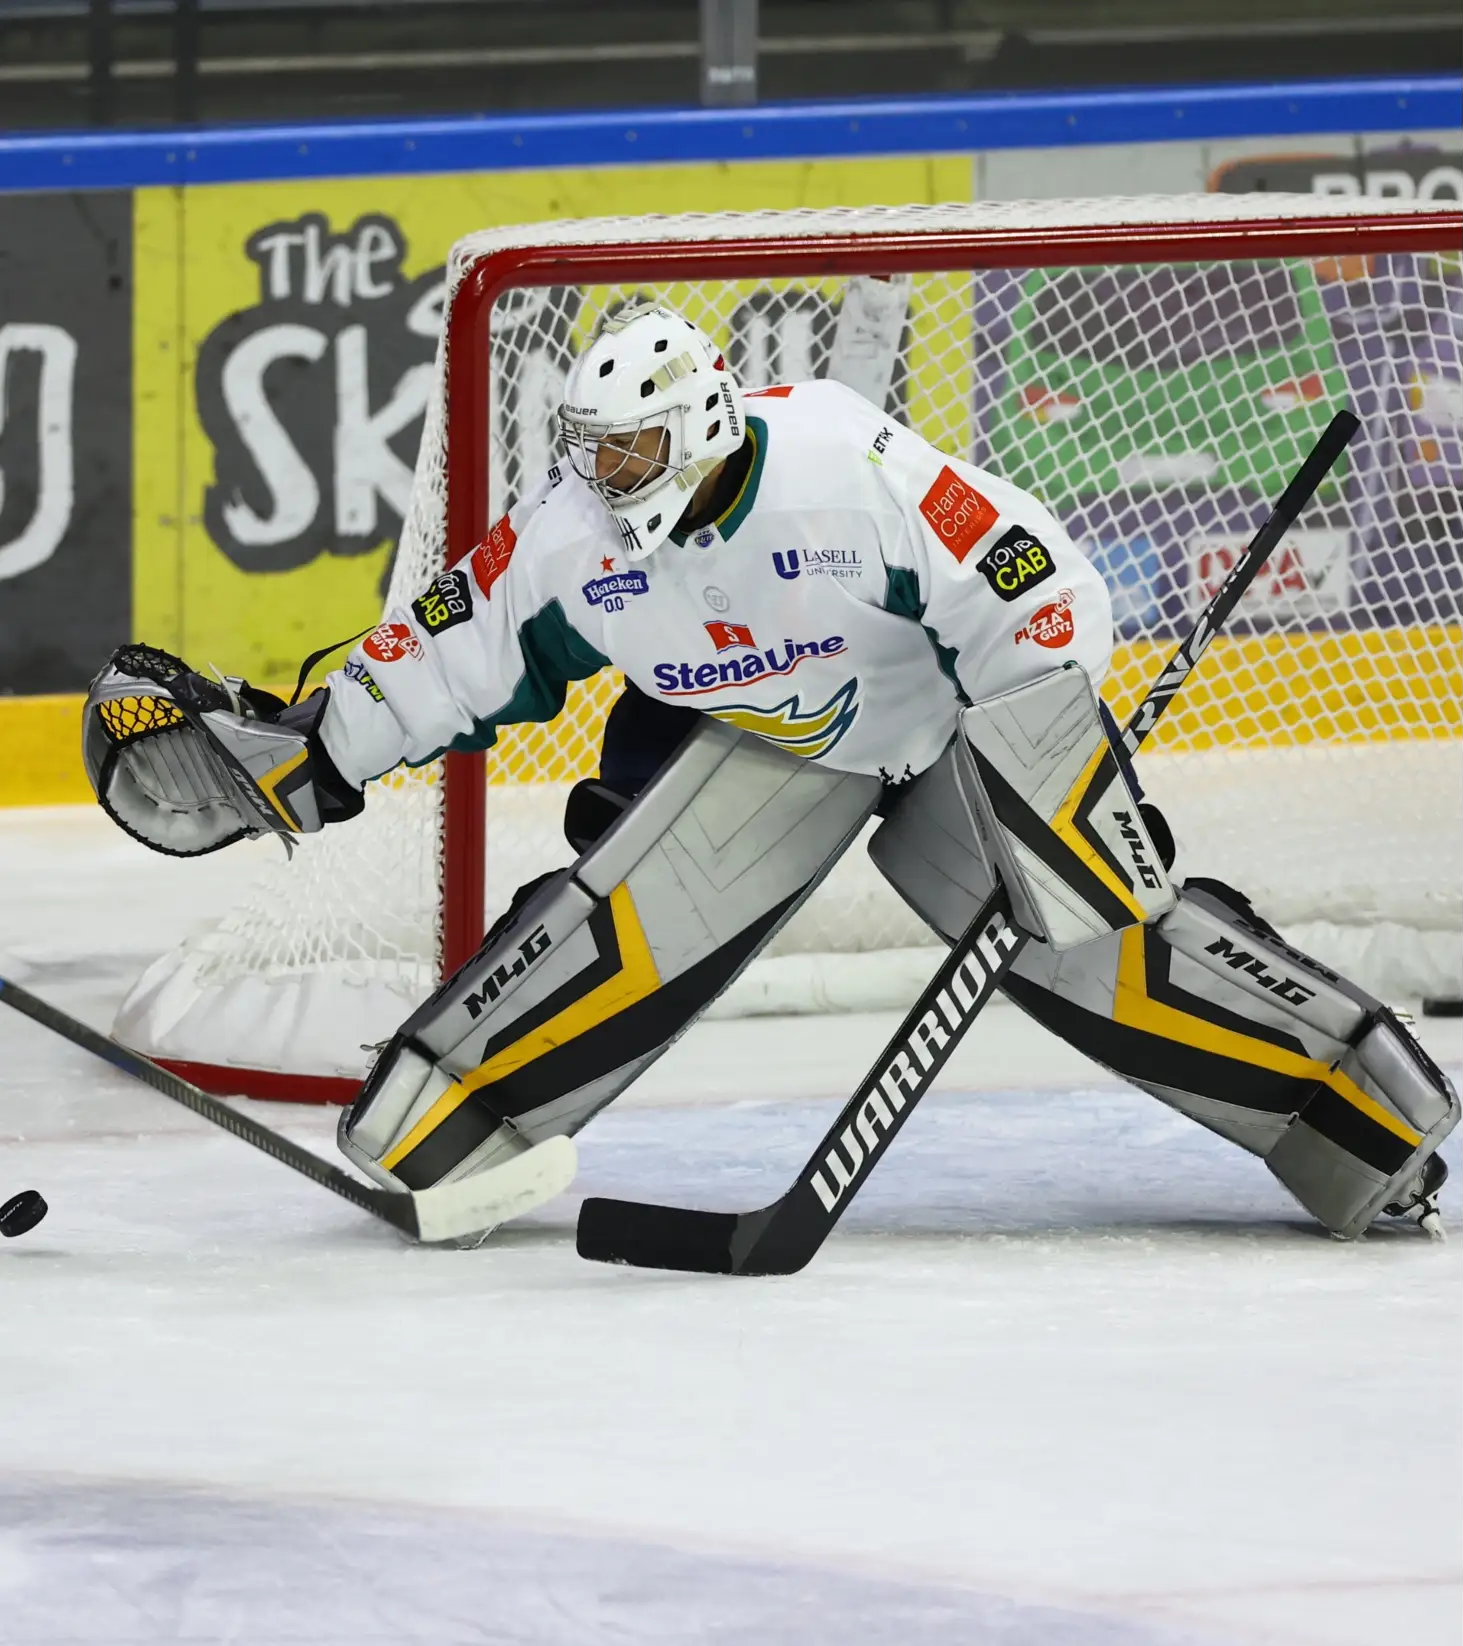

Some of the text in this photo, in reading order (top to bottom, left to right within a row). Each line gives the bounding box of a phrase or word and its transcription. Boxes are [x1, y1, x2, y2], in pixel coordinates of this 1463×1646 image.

[258, 224, 398, 306] The
[926, 478, 967, 523] Harry
[941, 491, 981, 537] Corry
[802, 548, 862, 565] LASELL
[996, 546, 1047, 590] CAB
[418, 583, 449, 627] AB
[370, 633, 395, 660] GUYZ
[1014, 612, 1063, 645] PIZZA
[1040, 622, 1073, 641] GUYZ
[810, 911, 1019, 1214] WARRIOR
